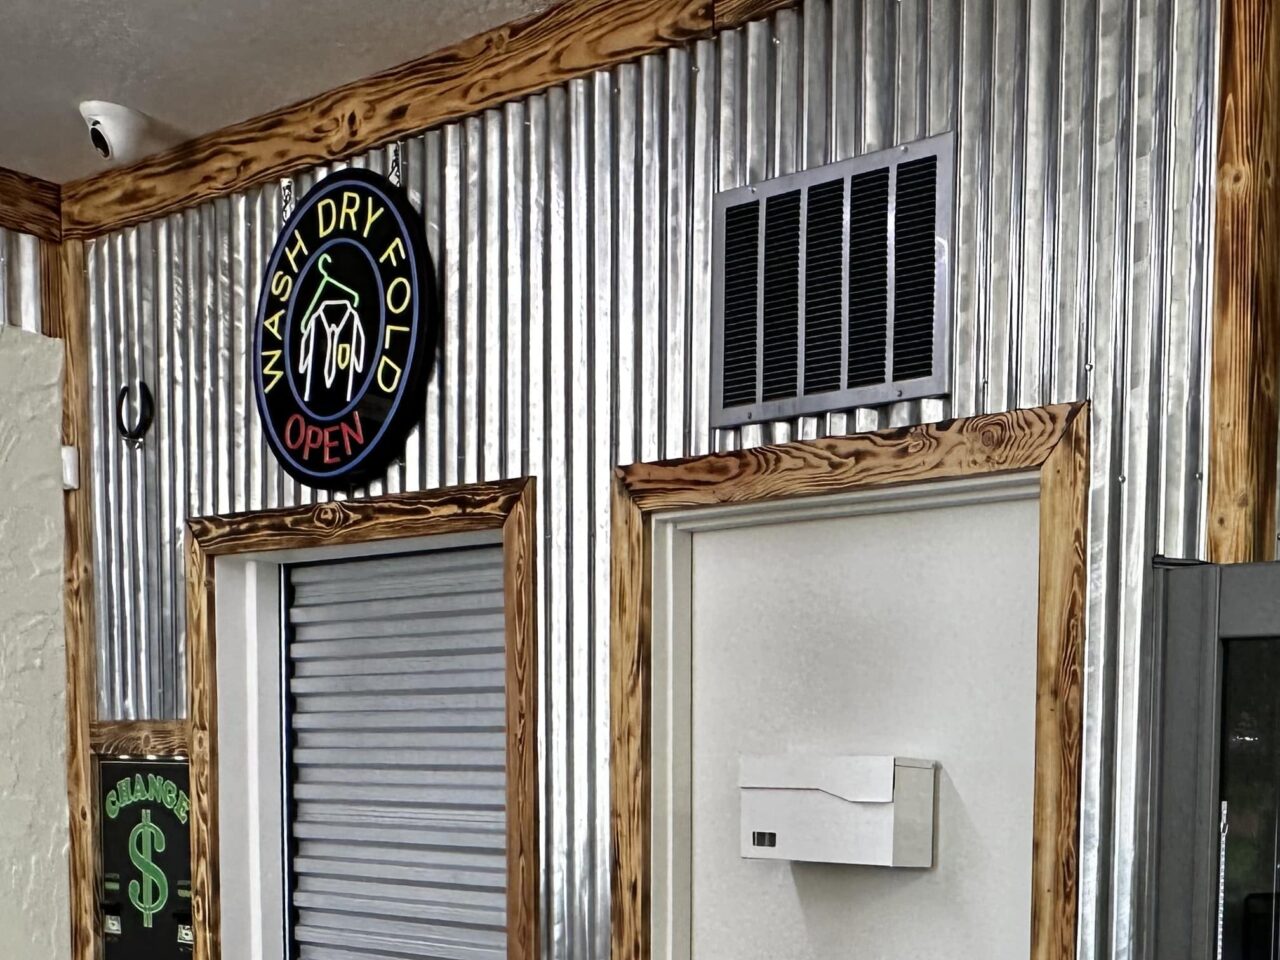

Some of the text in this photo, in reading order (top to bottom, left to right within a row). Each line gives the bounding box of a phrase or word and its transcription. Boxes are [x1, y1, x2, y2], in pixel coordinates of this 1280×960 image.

[261, 191, 411, 393] WASH DRY FOLD
[284, 410, 365, 464] OPEN
[105, 773, 190, 824] CHANGE
